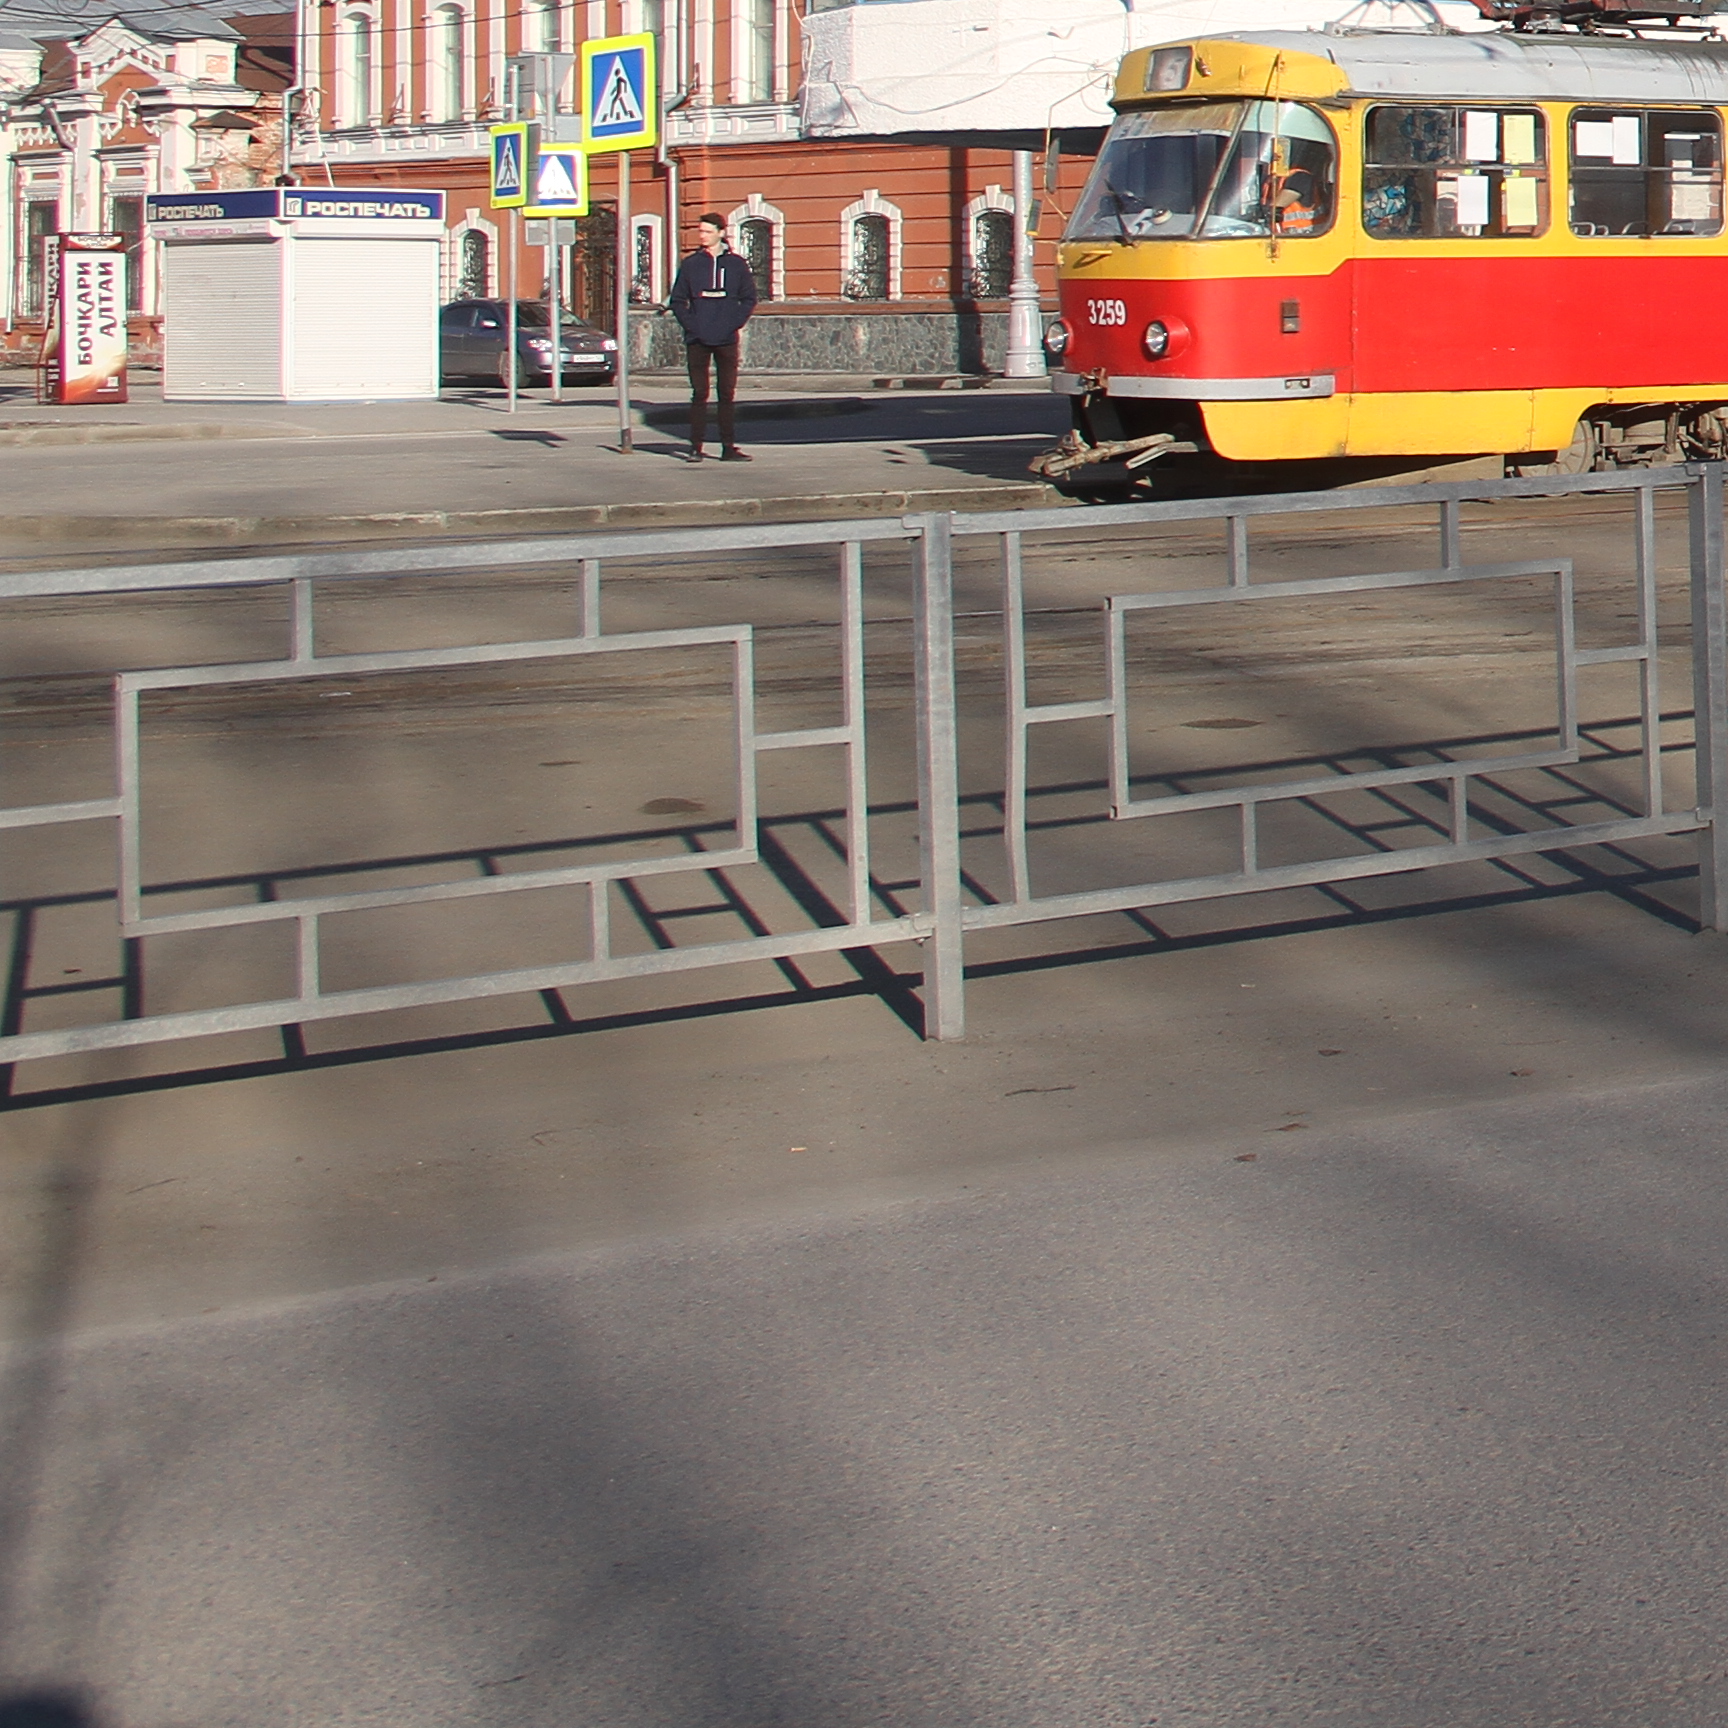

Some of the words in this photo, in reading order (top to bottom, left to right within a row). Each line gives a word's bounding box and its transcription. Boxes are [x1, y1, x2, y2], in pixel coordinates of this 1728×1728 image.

[158, 203, 224, 220] РОСПЕЧАТЬ
[306, 201, 431, 218] РОСПЕЧАТЬ
[97, 261, 117, 338] АЛТАЙ
[1087, 299, 1126, 326] 3259
[76, 262, 93, 366] БОЧКАРИ
